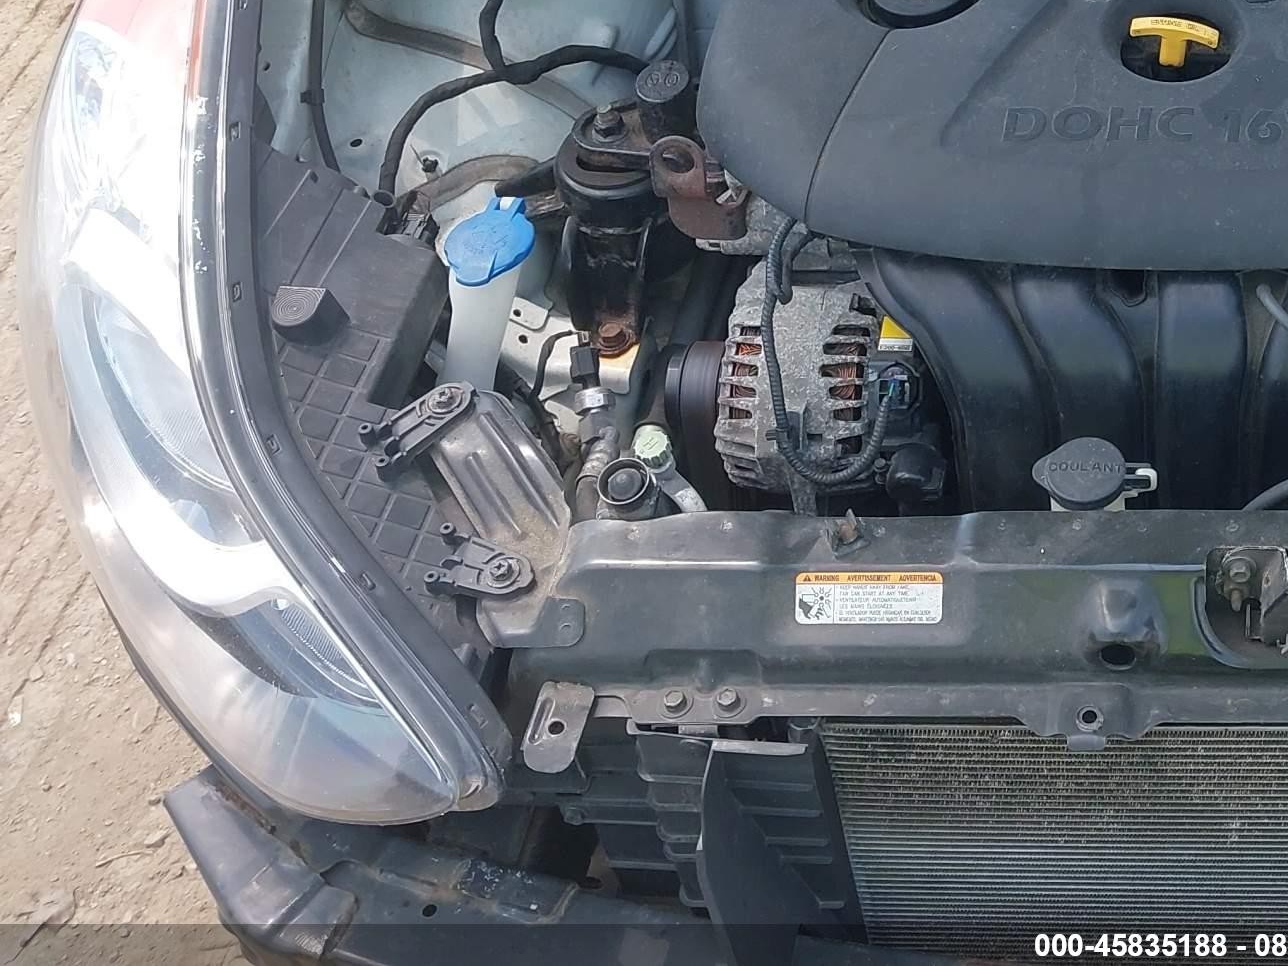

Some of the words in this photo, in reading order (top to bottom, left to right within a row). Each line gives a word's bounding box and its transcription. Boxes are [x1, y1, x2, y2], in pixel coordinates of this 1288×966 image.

[1001, 106, 1195, 144] DOHC
[1049, 462, 1122, 474] COOLANT
[814, 574, 840, 582] WARNING
[847, 574, 892, 582] AVERTISSEMENT
[899, 574, 937, 582] ADVERTENCIA
